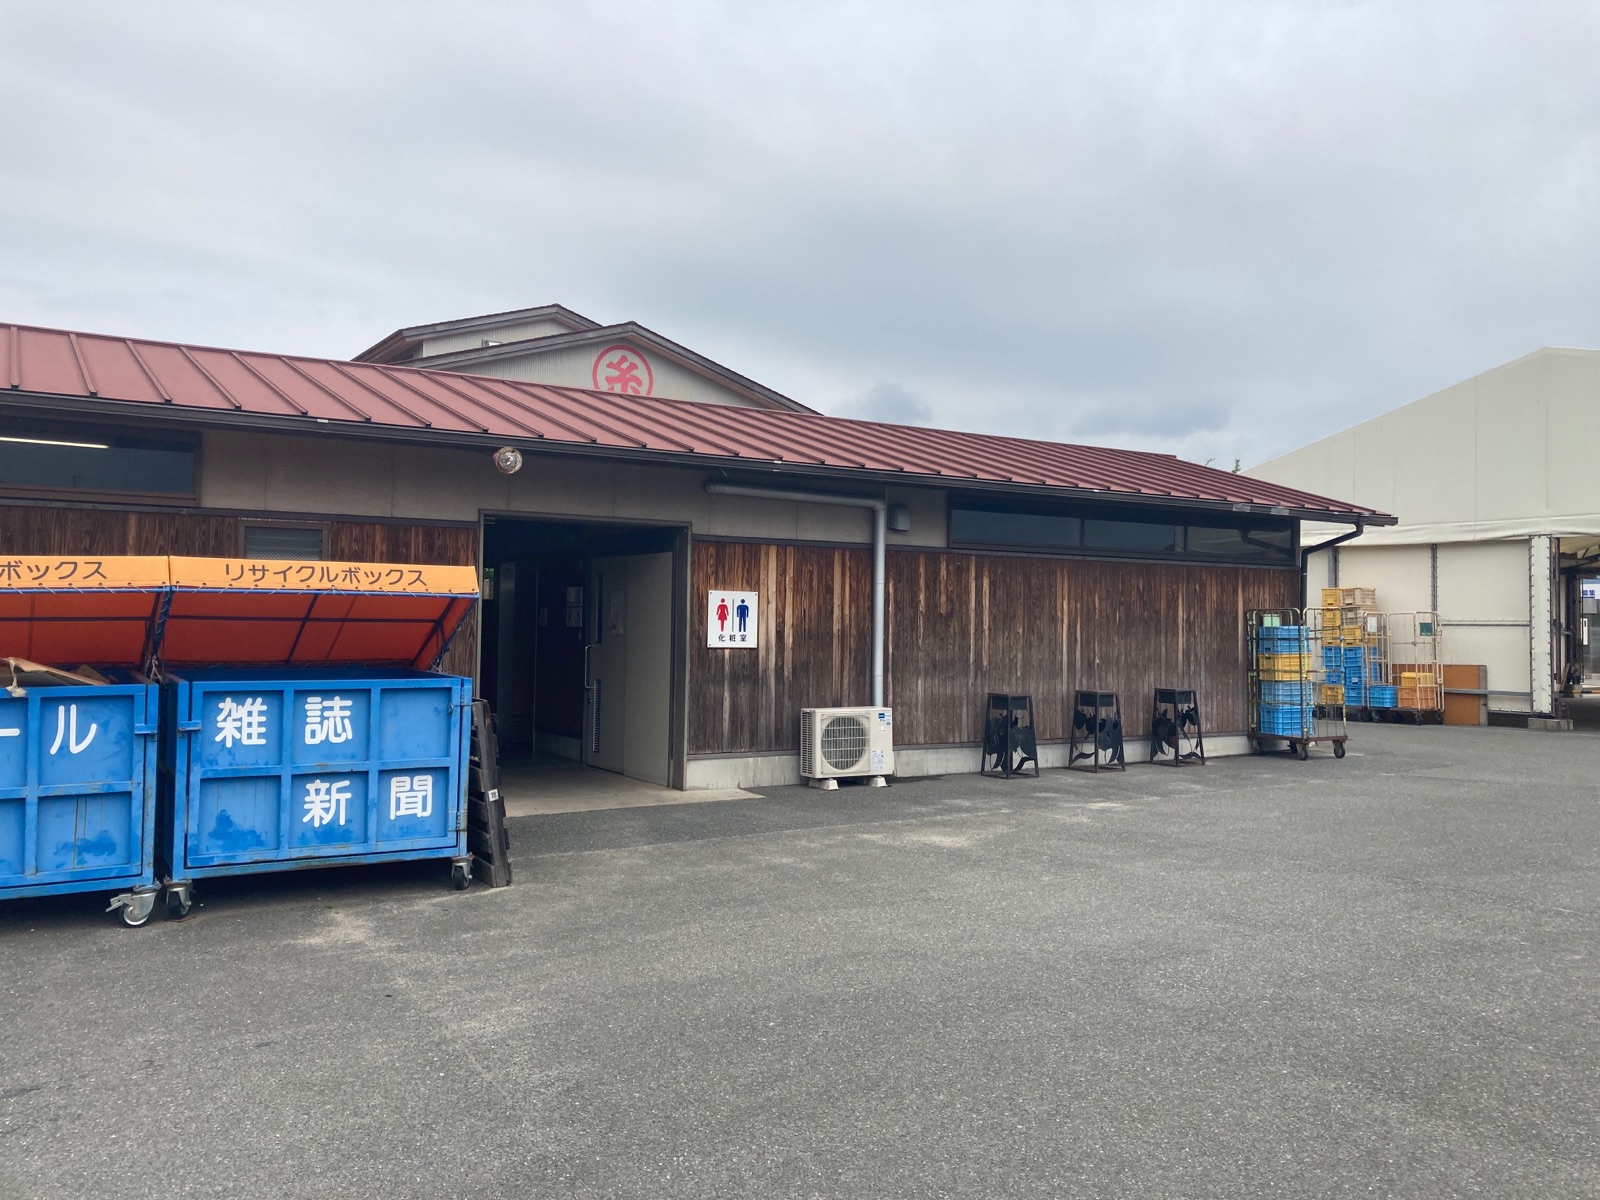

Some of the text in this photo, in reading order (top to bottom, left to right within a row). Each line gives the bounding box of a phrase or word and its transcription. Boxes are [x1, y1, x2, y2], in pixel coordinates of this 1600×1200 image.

[0, 560, 107, 581] ボックス
[225, 563, 427, 586] リサイクルボックス
[718, 633, 747, 642] 化粧室
[215, 696, 353, 748] 雑誌
[302, 775, 433, 828] 新聞
